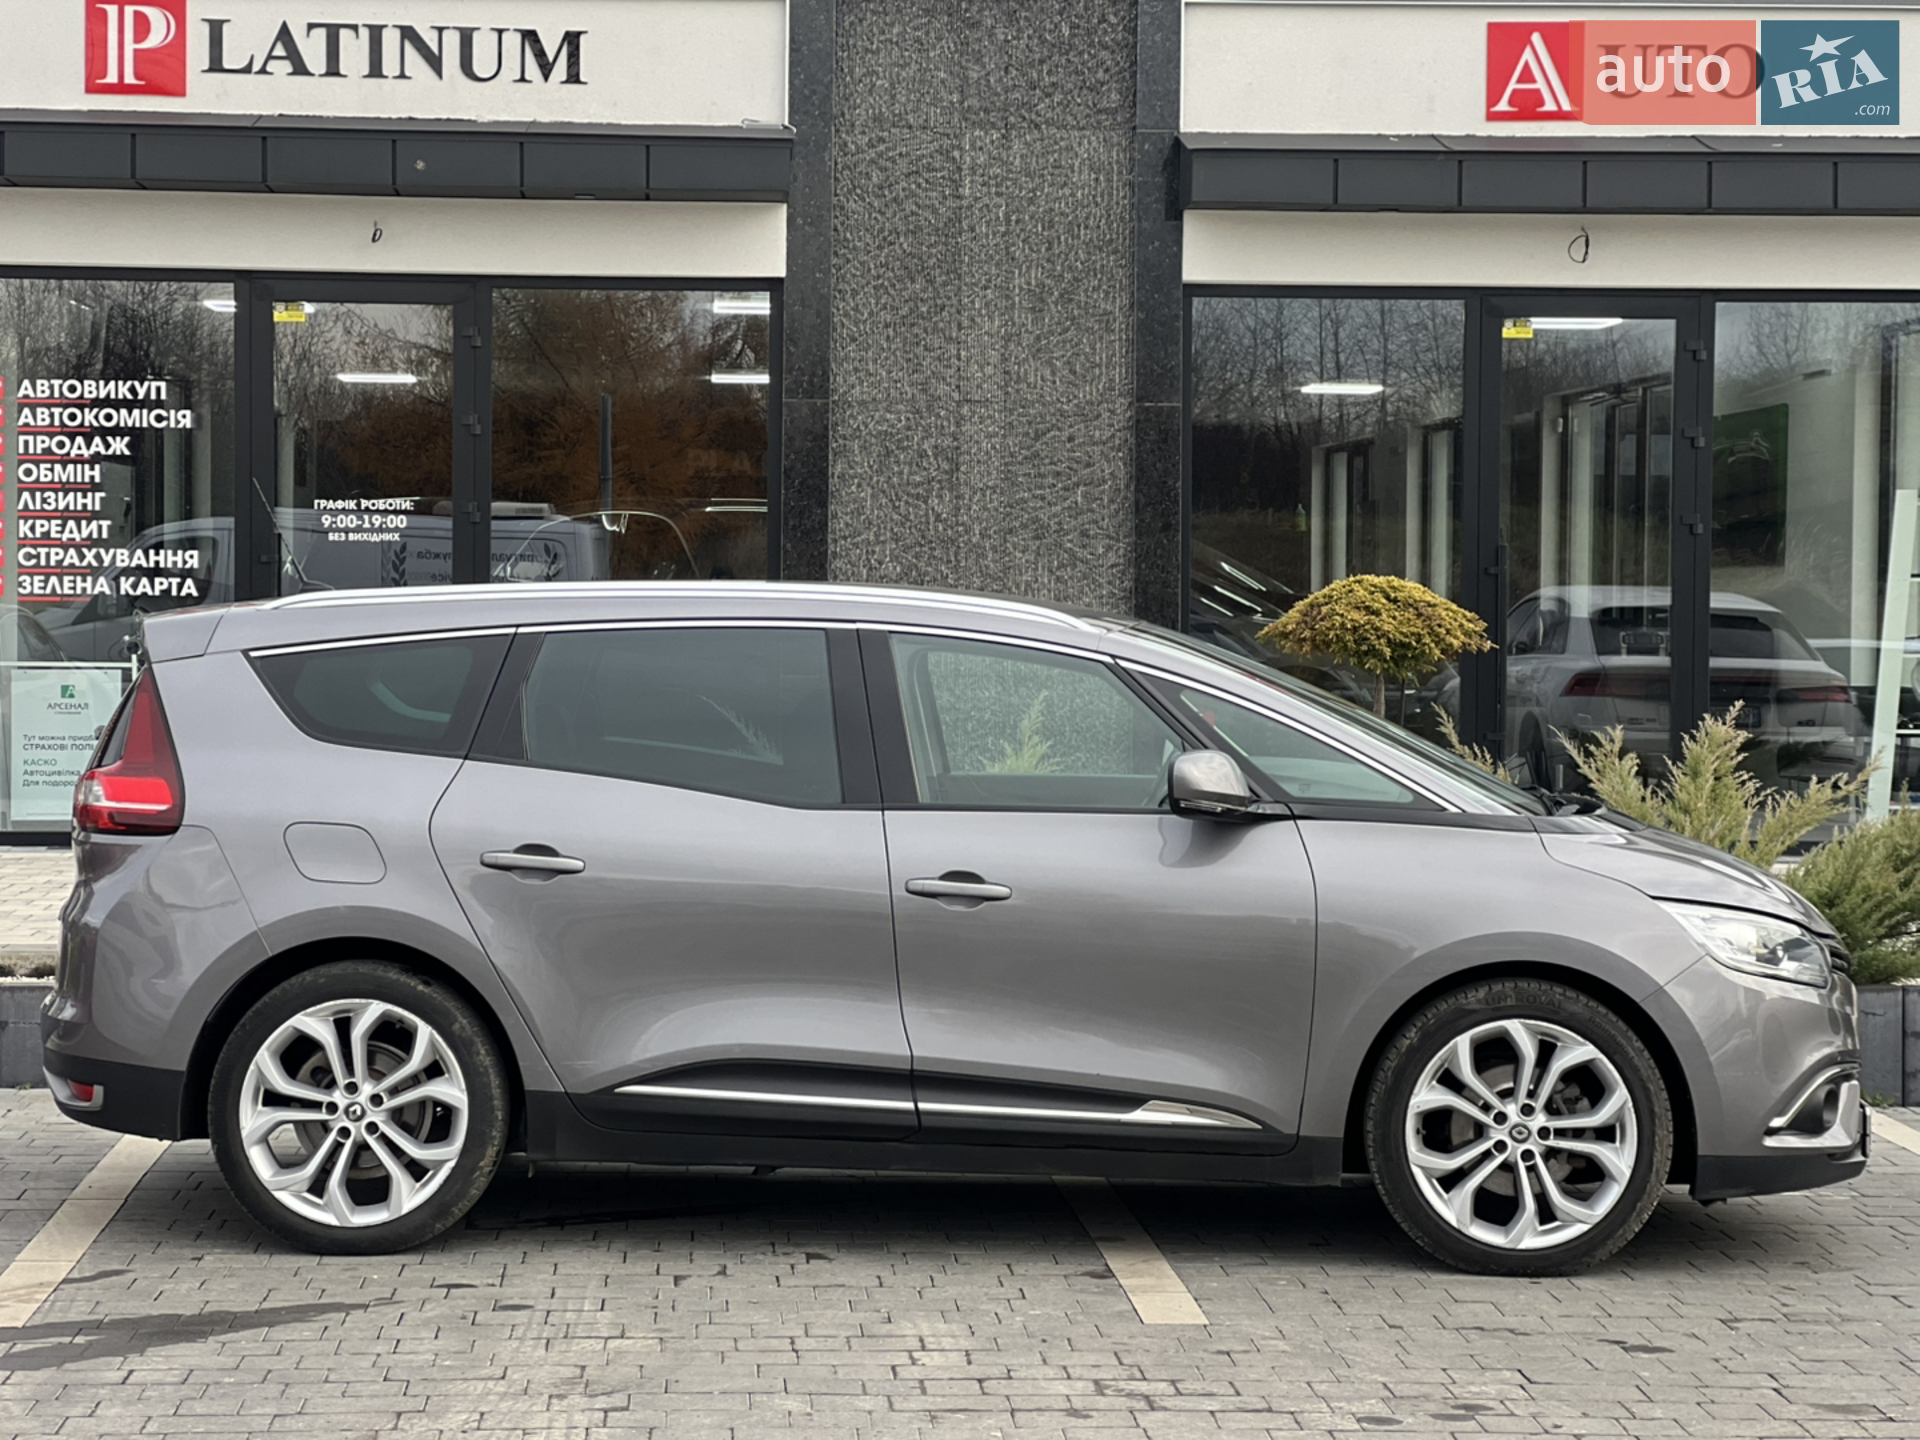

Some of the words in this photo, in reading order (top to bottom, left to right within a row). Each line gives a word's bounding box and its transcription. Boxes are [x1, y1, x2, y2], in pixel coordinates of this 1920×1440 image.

[95, 3, 588, 85] PLATINUM
[17, 378, 167, 400] АВТОВИКУП
[17, 407, 192, 428] АВТОКОМІСІЯ
[17, 435, 131, 457] ПРОДАЖ
[17, 463, 101, 483] ОБМІН
[17, 491, 106, 511] ЛІЗИНГ
[314, 499, 358, 511] ГРАФІК
[360, 499, 415, 511] РОБОТИ:
[17, 519, 112, 541] КРЕДИТ
[321, 514, 408, 528] 9:00-19:00
[328, 532, 346, 541] БЕЗ
[348, 532, 401, 542] ВИХІДНИХ
[17, 547, 199, 569] СТРАХУВАННЯ
[17, 575, 111, 595] ЗЕЛЕНА
[119, 577, 199, 596] КАРТА
[46, 702, 89, 711] АРСЕНАЛ
[22, 734, 36, 743] Тут
[67, 734, 95, 742] придб
[22, 743, 69, 751] СТРАХОВІ
[22, 758, 58, 767] КАСКО
[22, 779, 40, 788] Для
